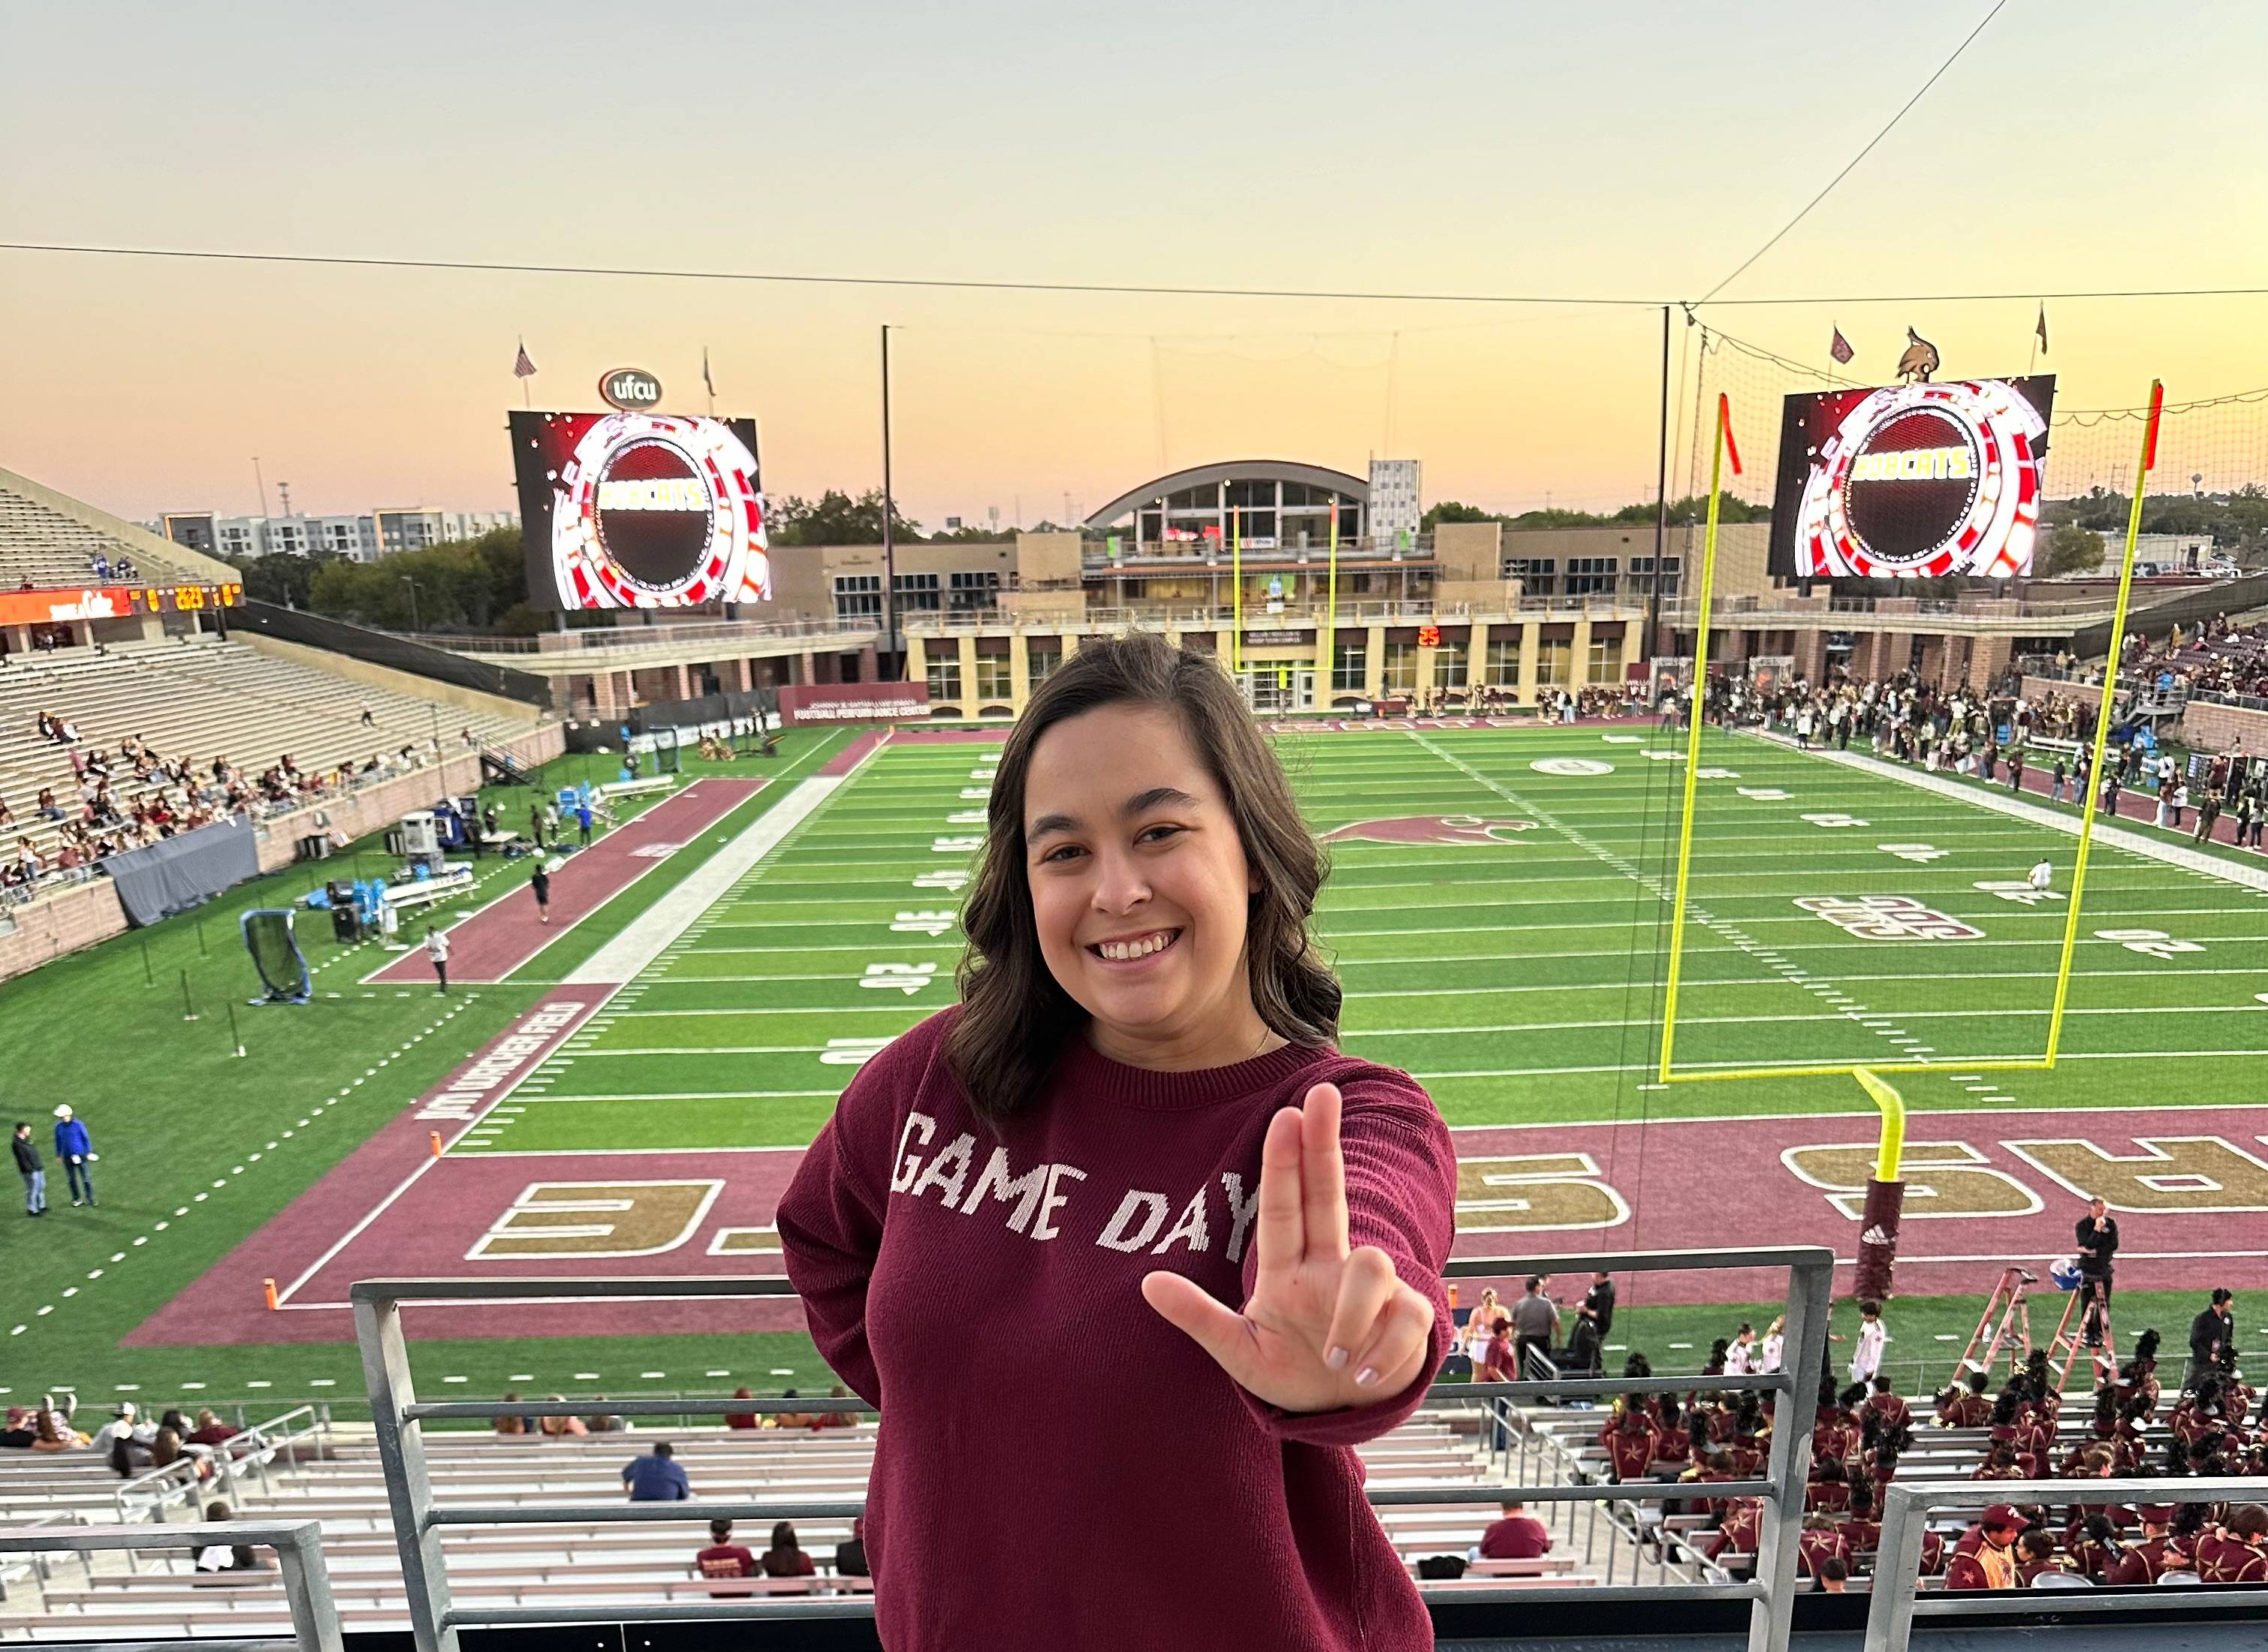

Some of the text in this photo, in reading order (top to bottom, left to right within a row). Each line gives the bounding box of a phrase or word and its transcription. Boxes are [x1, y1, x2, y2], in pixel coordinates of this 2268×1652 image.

[613, 375, 657, 401] ufcu
[1852, 446, 1972, 481] BOBCATS
[600, 480, 705, 510] BOBCATS
[794, 708, 836, 720] FOOTBALL
[899, 704, 931, 716] CENTER
[889, 910, 957, 932] 30
[2094, 929, 2207, 955] 20
[858, 962, 938, 989] 20
[414, 1001, 587, 1120] JIM WACKER FIELD
[891, 1111, 1088, 1242] GAME
[1095, 1171, 1260, 1264] DAY
